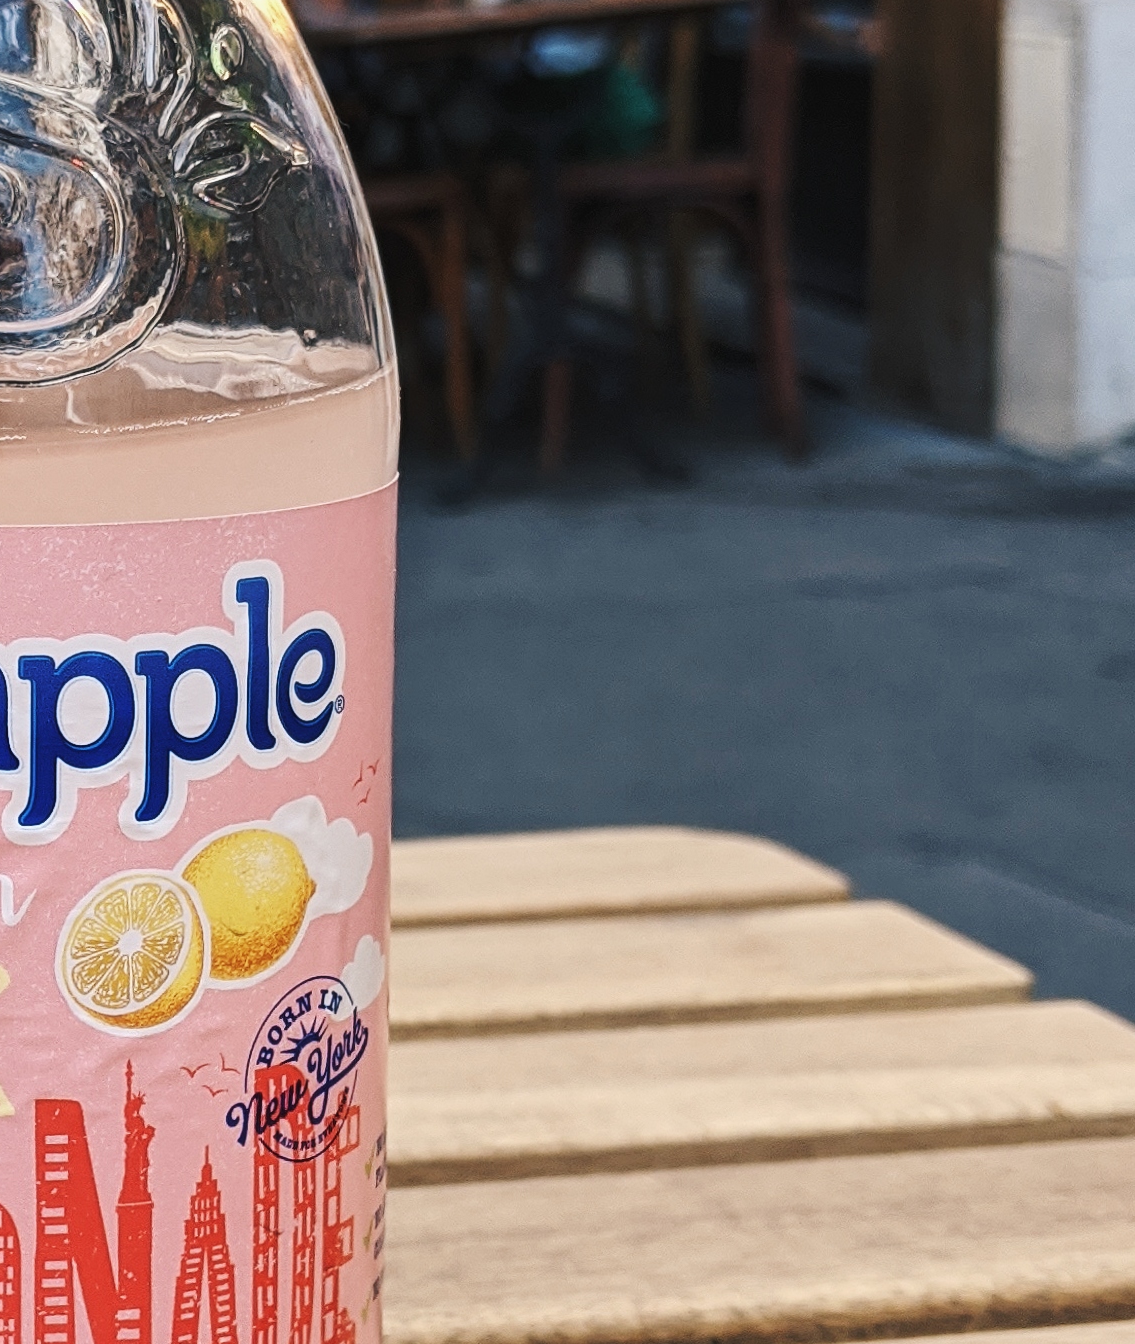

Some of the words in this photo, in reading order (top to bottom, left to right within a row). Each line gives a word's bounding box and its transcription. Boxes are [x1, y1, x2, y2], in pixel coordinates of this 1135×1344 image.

[225, 1078, 309, 1146] New
[307, 1006, 369, 1125] York
[257, 991, 313, 1068] BORN
[318, 989, 343, 1015] IN
